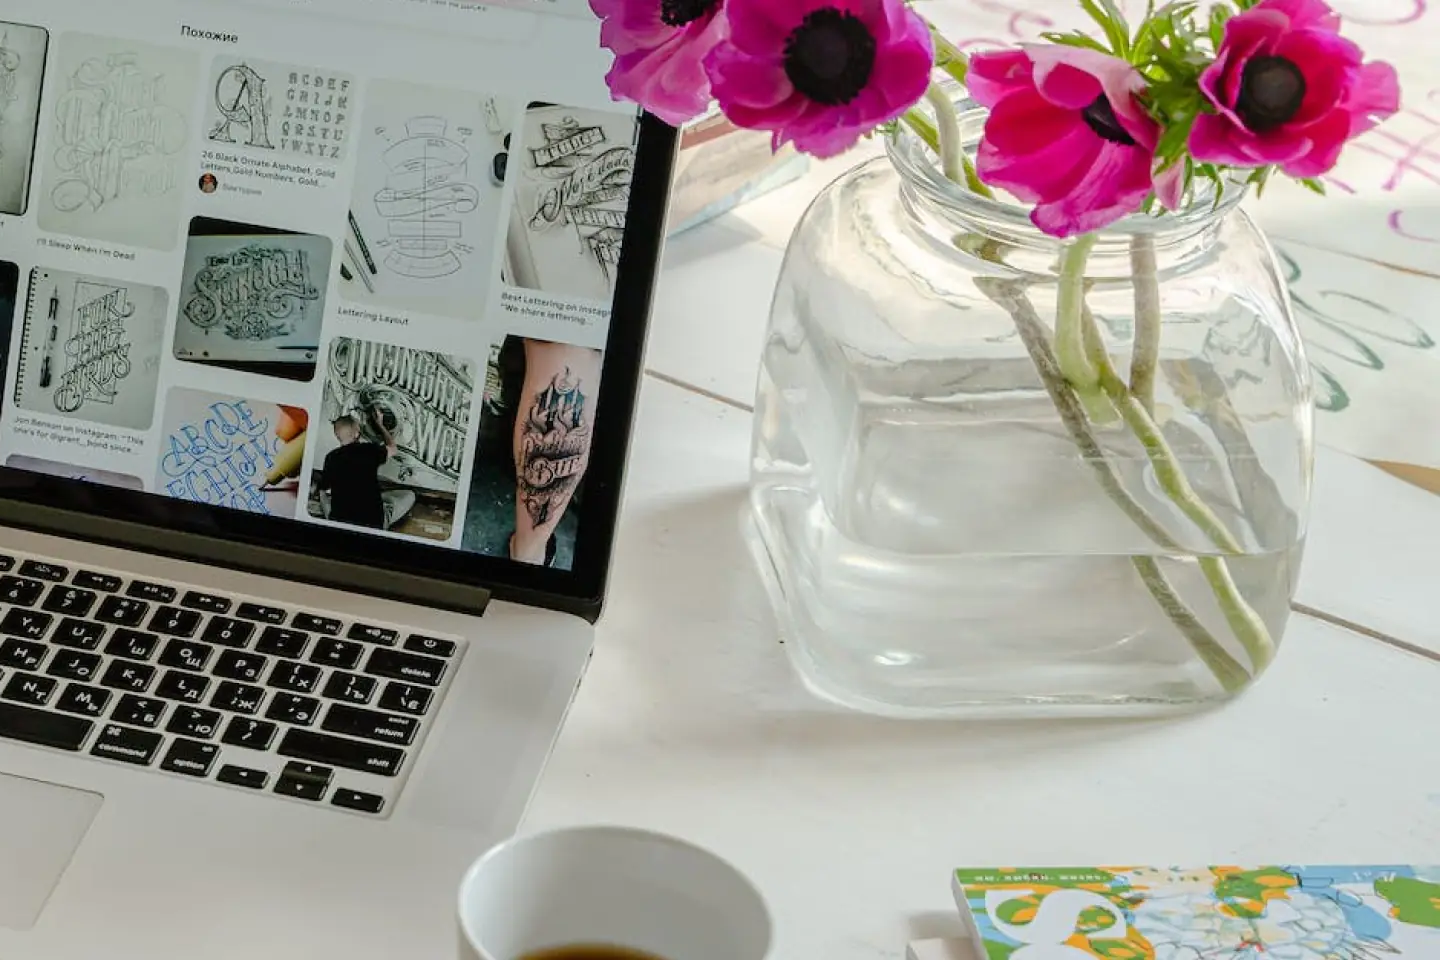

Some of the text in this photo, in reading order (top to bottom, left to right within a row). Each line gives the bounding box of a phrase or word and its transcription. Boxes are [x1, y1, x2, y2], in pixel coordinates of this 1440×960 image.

[181, 25, 238, 43] Похожие
[215, 152, 238, 163] Black
[240, 155, 269, 168] Ornate
[315, 167, 336, 179] Gold
[48, 240, 72, 250] Sleep
[73, 243, 98, 254] When
[112, 250, 136, 261] Dead
[501, 292, 522, 301] Best
[523, 295, 565, 311] Lettering
[565, 303, 577, 312] on
[337, 305, 409, 326] Lettering Layout
[520, 306, 546, 317] share
[23, 617, 32, 626] Y
[72, 627, 85, 636] U
[14, 648, 28, 657] H
[69, 659, 79, 668] J
[235, 660, 247, 668] P
[123, 669, 135, 678] K
[23, 681, 37, 692] N
[178, 680, 186, 689] L
[75, 692, 90, 702] M
[239, 701, 254, 710] Ж
[374, 727, 403, 738] return
[98, 741, 147, 759] command
[173, 758, 205, 769] option
[367, 758, 389, 767] shift
